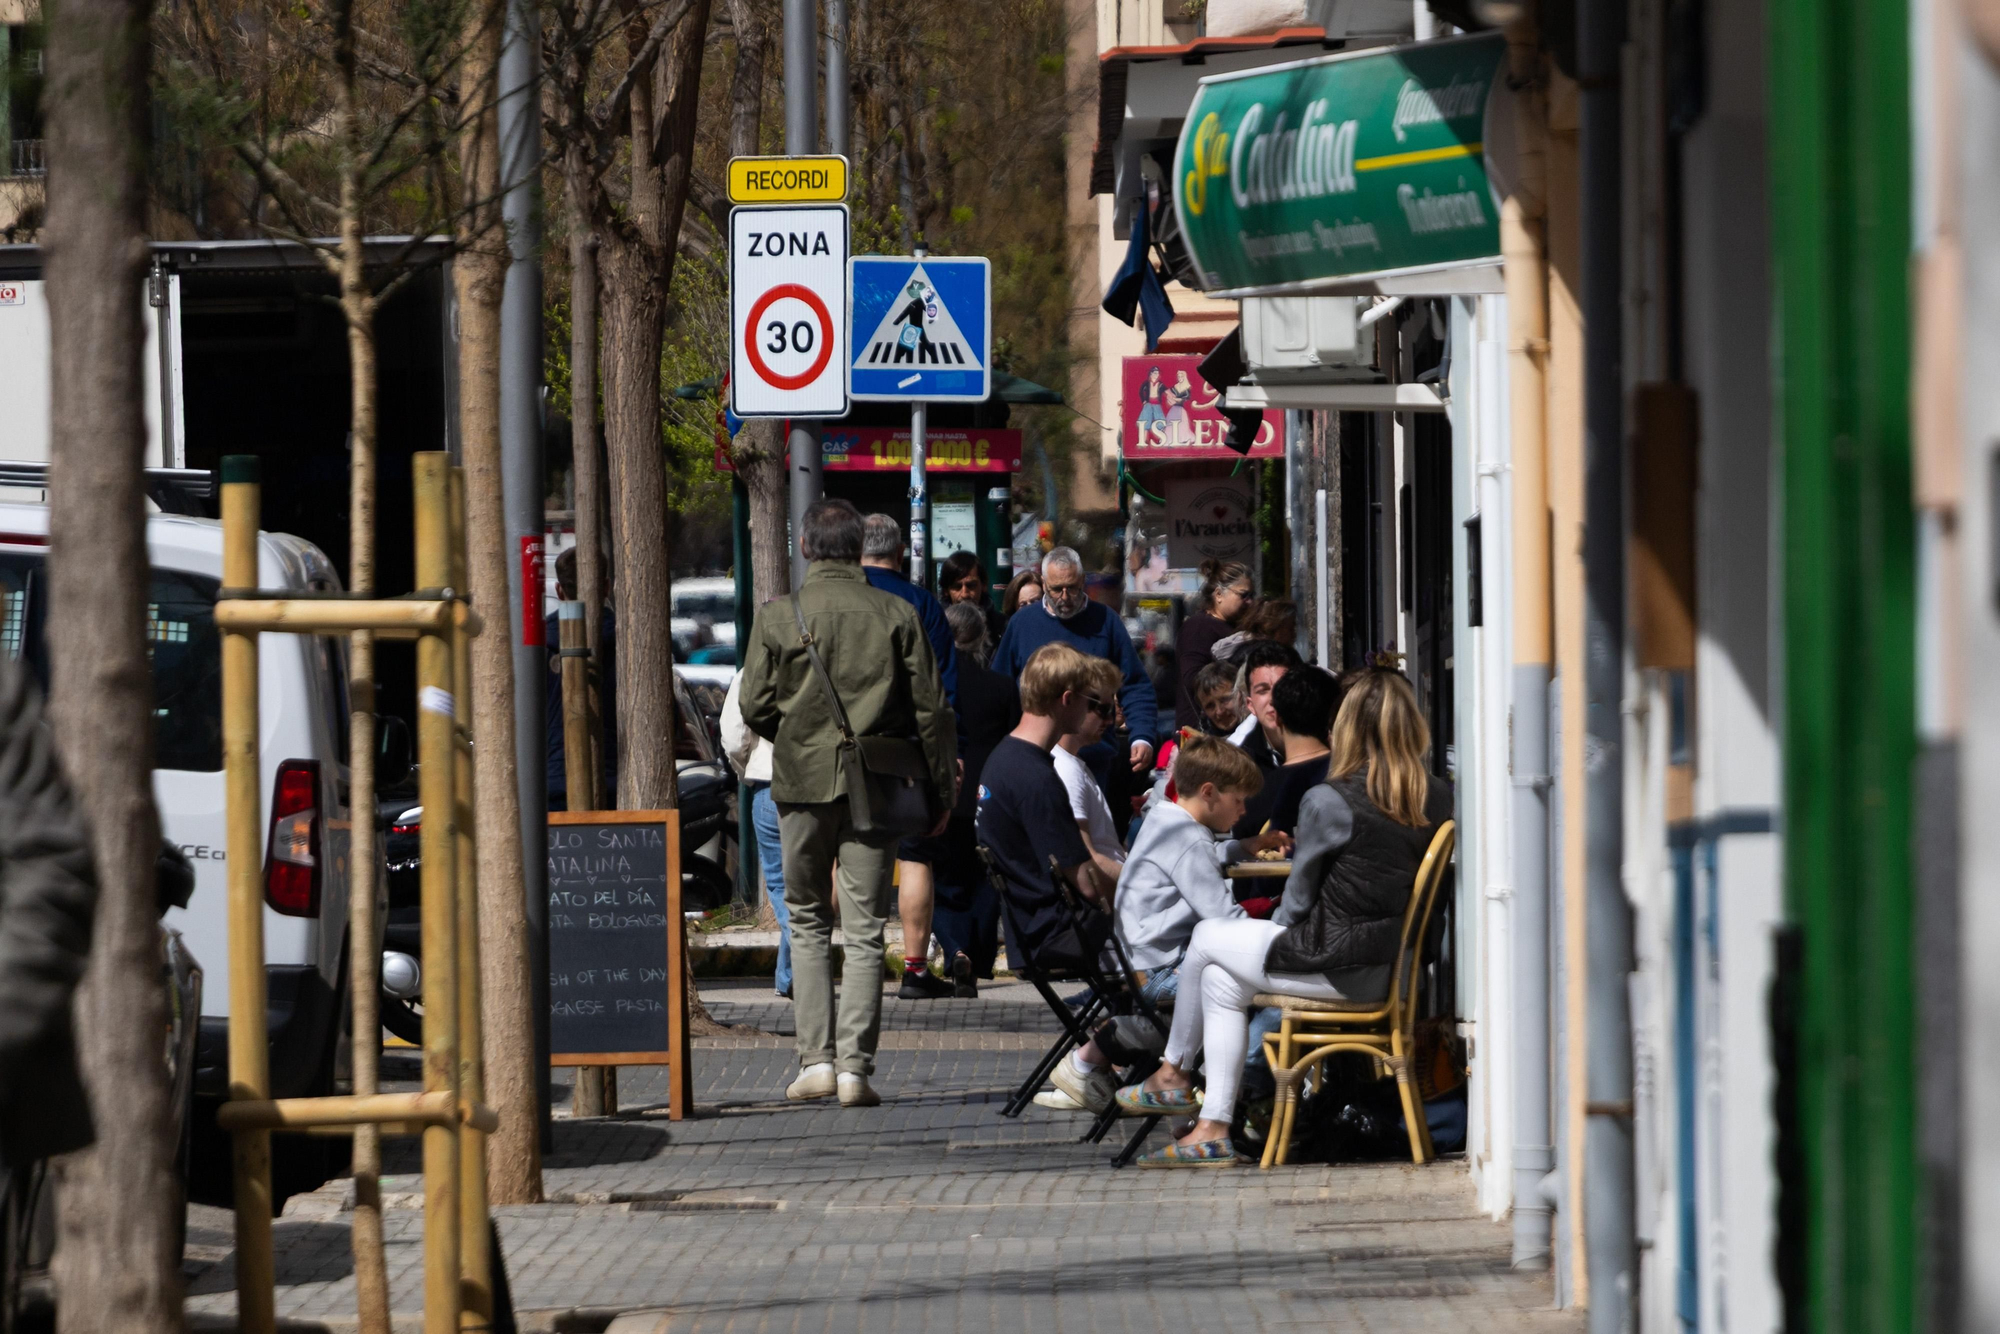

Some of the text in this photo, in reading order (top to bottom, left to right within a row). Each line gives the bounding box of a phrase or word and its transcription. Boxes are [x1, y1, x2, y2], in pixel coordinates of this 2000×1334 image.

[1230, 97, 1359, 210] Catalina
[747, 169, 829, 190] RECORDI
[748, 230, 831, 257] ZONA
[766, 319, 815, 353] 30
[870, 439, 973, 465] 1.00.000
[597, 828, 663, 849] SANTA
[548, 855, 631, 874] ATALINA
[549, 886, 656, 907] ATO DEL DÍA
[588, 912, 667, 929] BOLOGNESA
[549, 967, 667, 986] SH OF THE DAY
[616, 998, 664, 1013] PASTA
